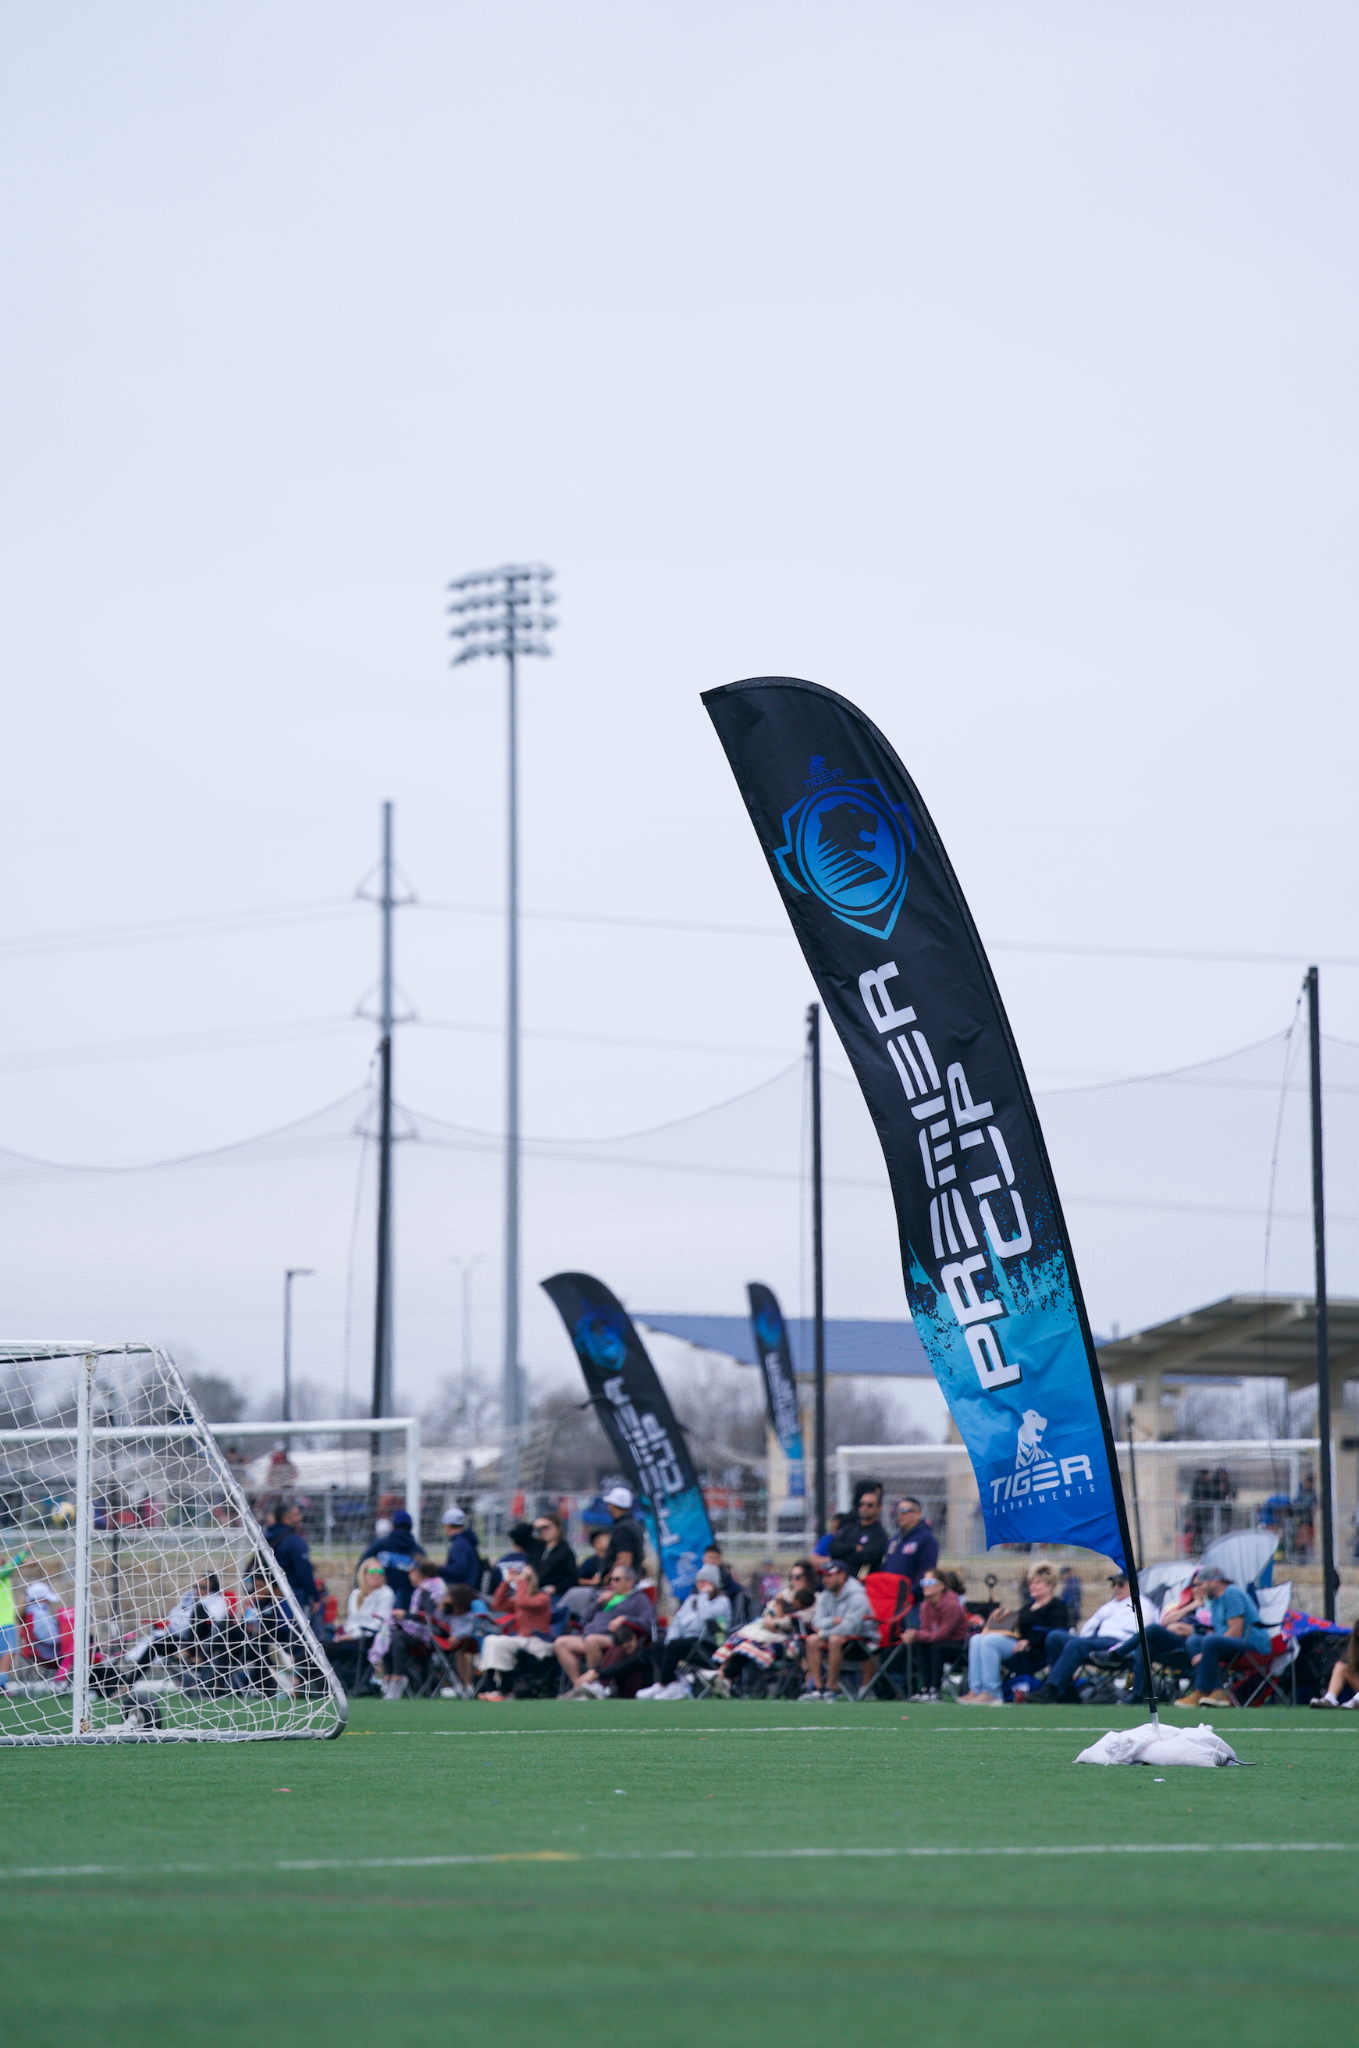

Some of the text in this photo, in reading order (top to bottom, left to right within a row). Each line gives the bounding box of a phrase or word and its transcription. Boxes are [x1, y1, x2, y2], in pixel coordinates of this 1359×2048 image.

[802, 768, 844, 789] TIGER
[858, 961, 1020, 1390] PREMIER
[947, 1062, 1033, 1259] CUP
[641, 1412, 685, 1494] CUP
[990, 1454, 1094, 1504] TIGER
[989, 1484, 1095, 1516] OURNAMENTS
